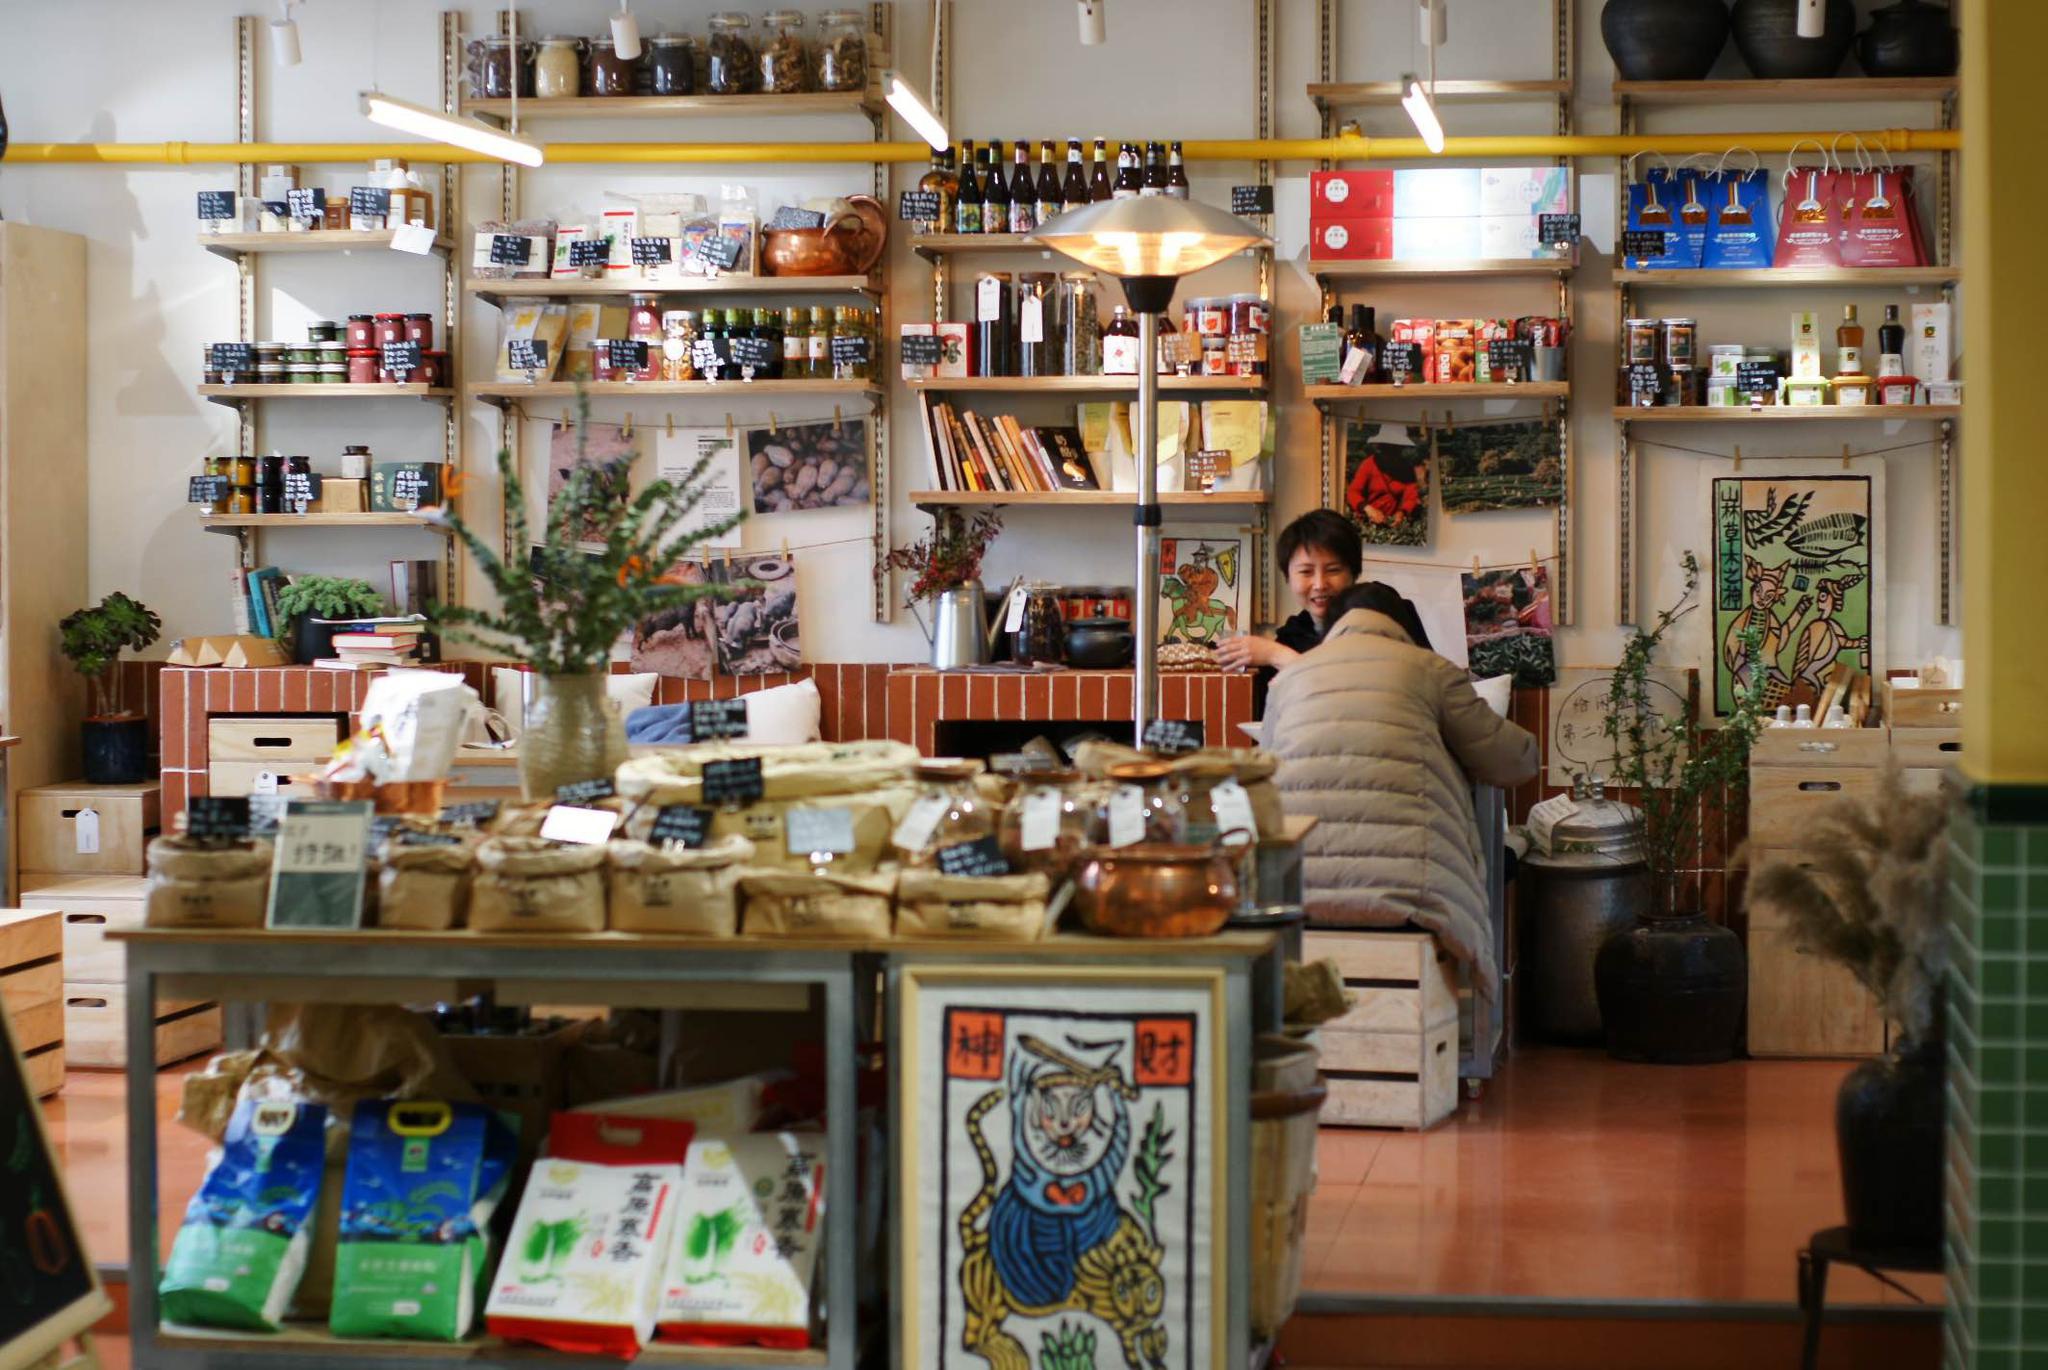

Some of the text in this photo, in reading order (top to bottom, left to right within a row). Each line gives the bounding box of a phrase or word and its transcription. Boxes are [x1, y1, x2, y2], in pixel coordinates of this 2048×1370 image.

[1721, 486, 1741, 607] 山林草木之神
[956, 1020, 1001, 1073] 神
